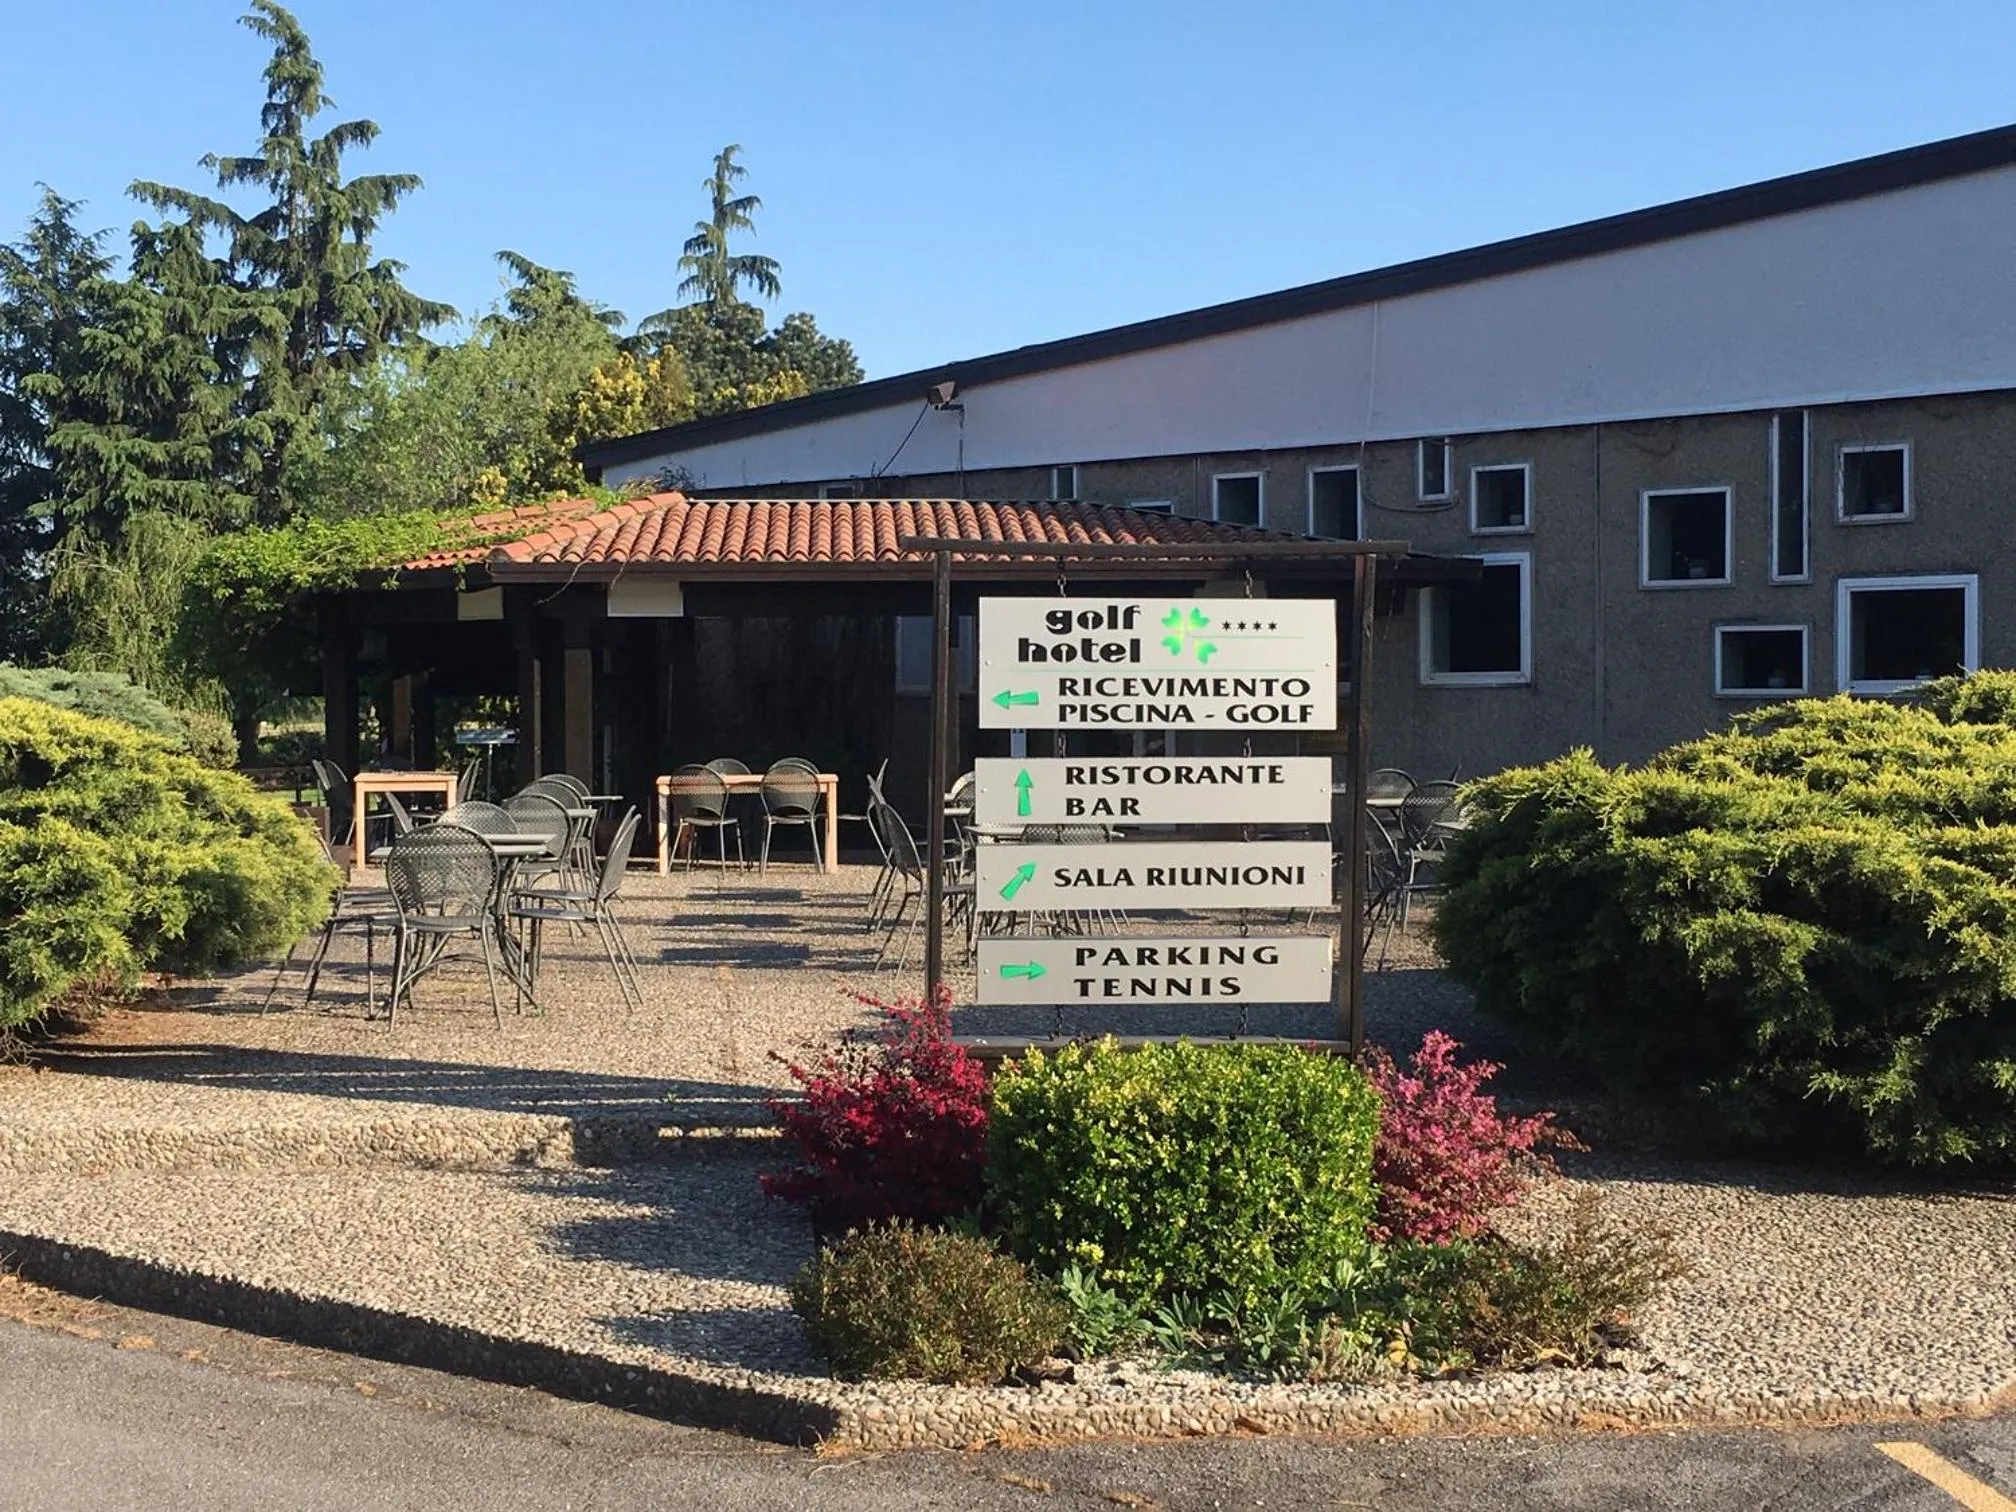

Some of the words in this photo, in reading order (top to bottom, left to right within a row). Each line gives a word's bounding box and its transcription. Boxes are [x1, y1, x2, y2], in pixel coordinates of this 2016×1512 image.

[1046, 606, 1140, 634] golf
[1019, 638, 1140, 662] hotel
[1059, 678, 1311, 697] RICEVIMENTO
[1059, 704, 1194, 723] PISCINA
[1227, 704, 1314, 723] GOLF
[1066, 766, 1284, 784] RISTORANTE
[1066, 797, 1141, 816] BAR
[1055, 868, 1135, 887] SALA
[1147, 866, 1305, 886] RIUNIONI
[1075, 946, 1279, 966] PARKING
[1073, 977, 1241, 997] TENNIS
